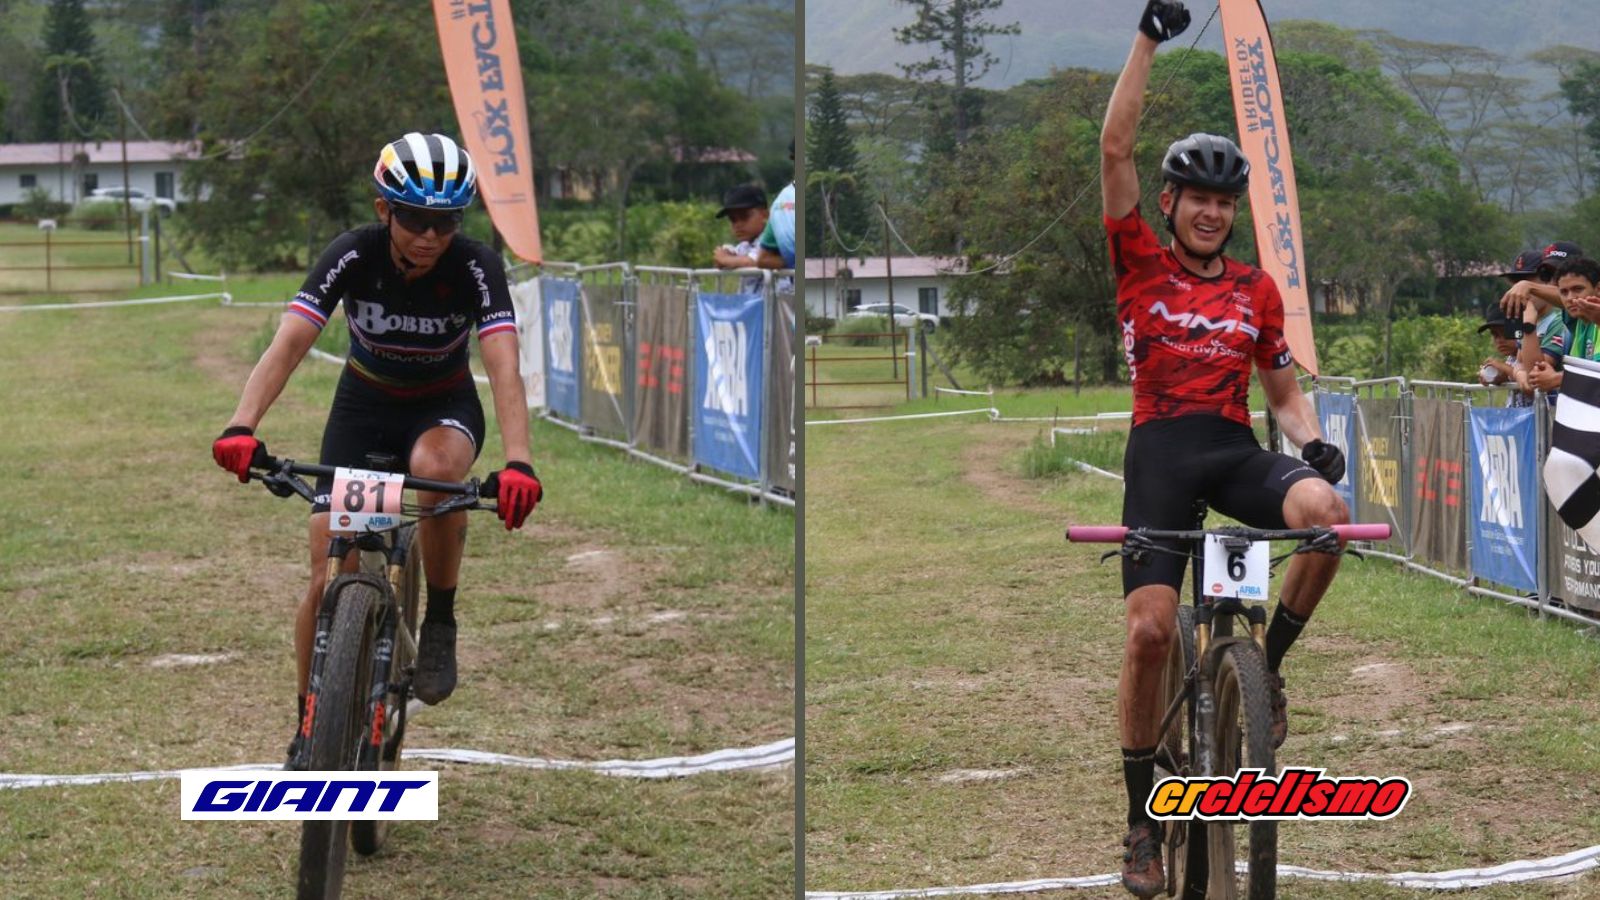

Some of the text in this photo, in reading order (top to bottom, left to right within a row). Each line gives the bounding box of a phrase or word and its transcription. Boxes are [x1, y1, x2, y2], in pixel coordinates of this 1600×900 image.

[481, 310, 513, 322] uvex
[343, 480, 386, 513] 81
[1227, 551, 1247, 582] 6
